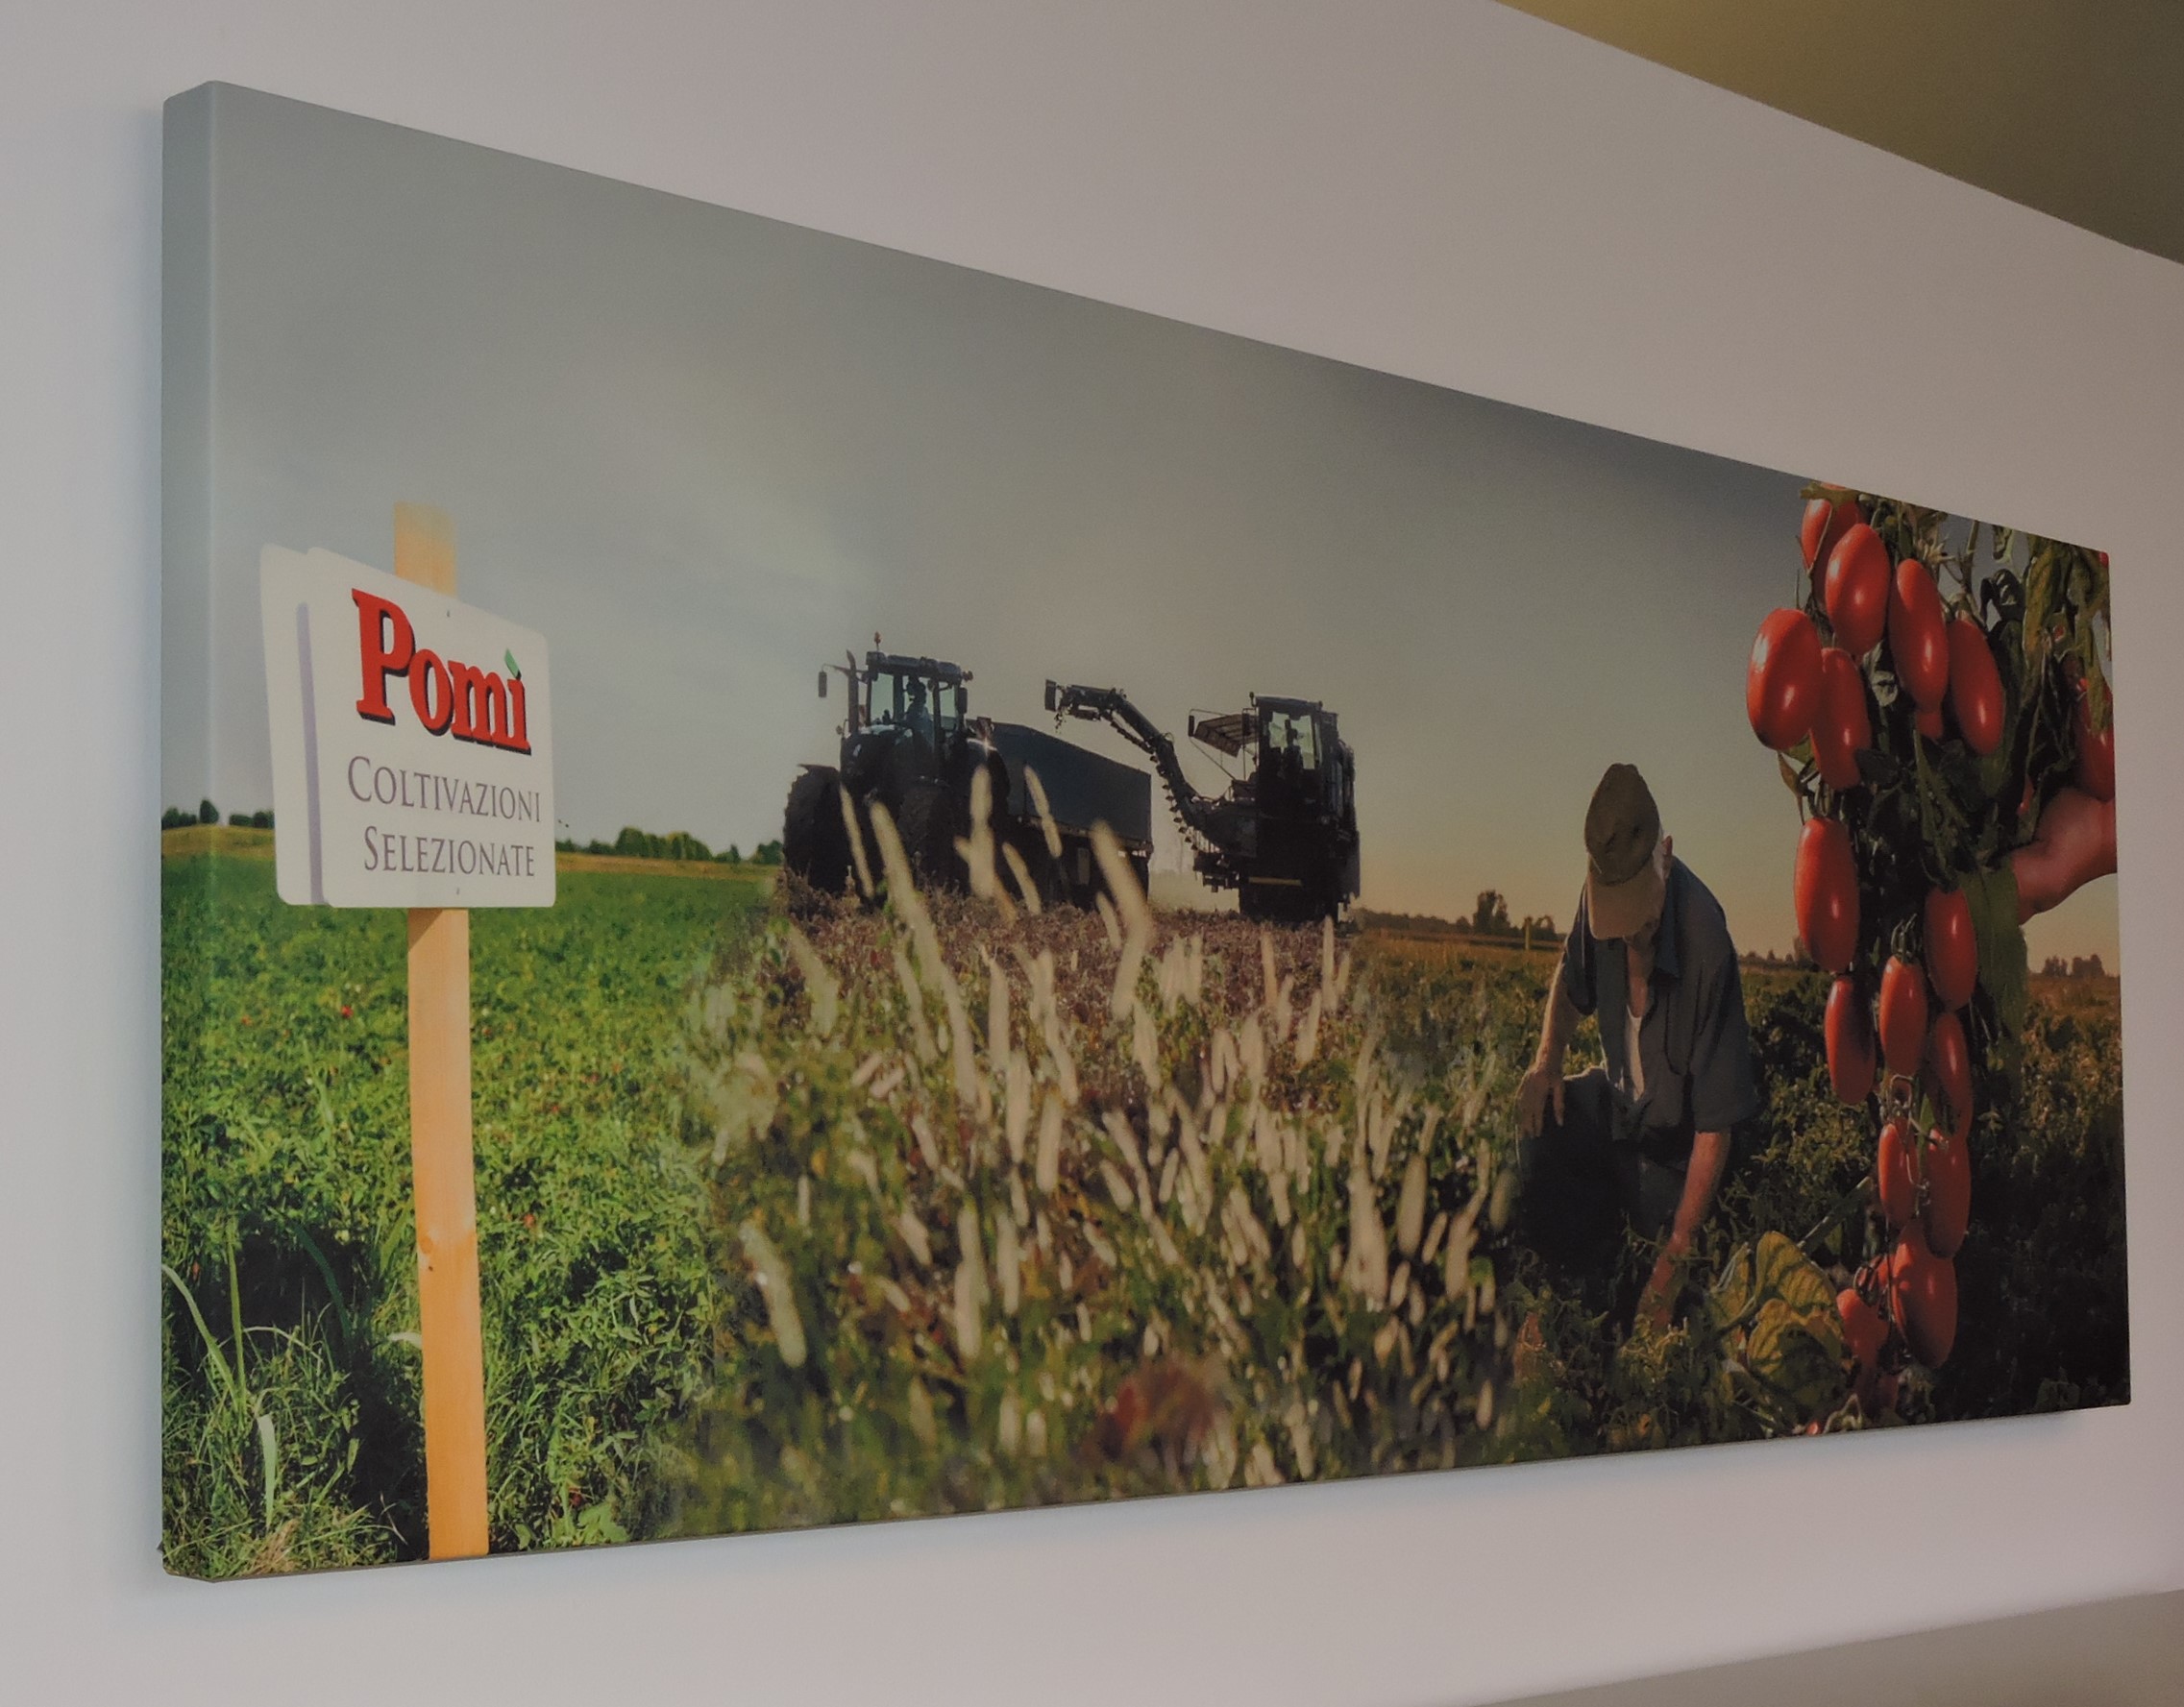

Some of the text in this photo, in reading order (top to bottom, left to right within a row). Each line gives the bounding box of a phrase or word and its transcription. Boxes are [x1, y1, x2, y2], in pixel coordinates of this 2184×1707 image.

[352, 588, 531, 755] Pomì
[348, 755, 541, 823] COLTIVAZIONI
[364, 825, 535, 877] SELEZIONATE
